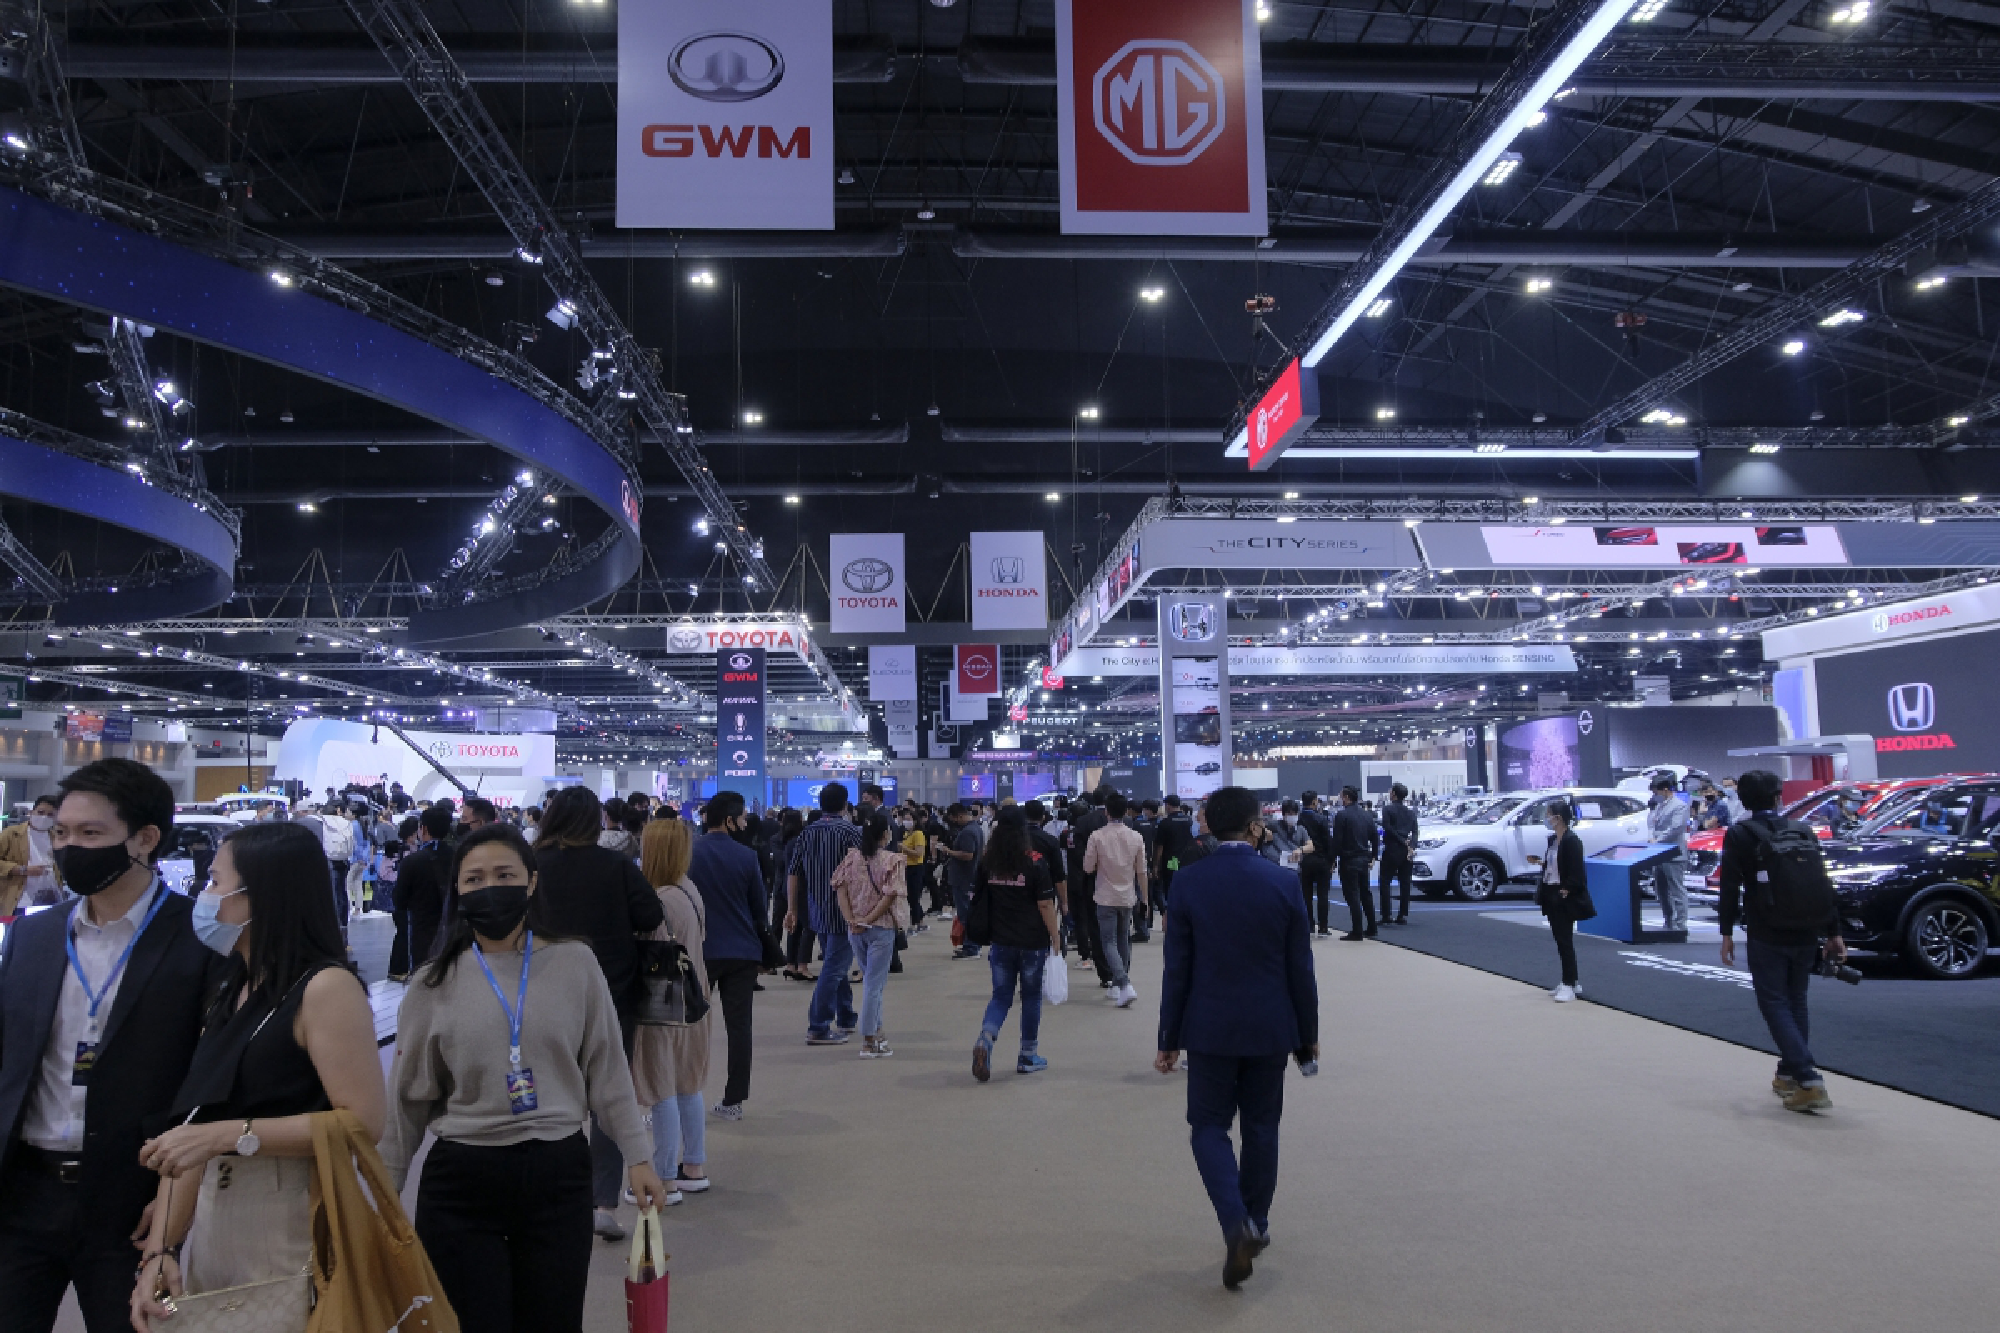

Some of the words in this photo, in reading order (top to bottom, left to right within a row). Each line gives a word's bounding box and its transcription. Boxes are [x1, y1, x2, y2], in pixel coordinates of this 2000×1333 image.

[1109, 54, 1209, 150] MG
[641, 124, 811, 159] GWM
[1217, 539, 1245, 549] THE
[1248, 537, 1305, 549] CITY
[1307, 539, 1358, 549] SERIES
[977, 588, 1040, 598] HONDA
[838, 597, 898, 608] TOYOTA
[1888, 604, 1953, 626] HONDA
[706, 630, 794, 648] TOYOTA
[1121, 656, 1141, 667] City
[1480, 654, 1510, 663] Honda
[1512, 654, 1556, 663] SENSING
[723, 672, 758, 681] GWM
[1875, 733, 1957, 752] HONDA
[457, 744, 519, 757] TOYOTA
